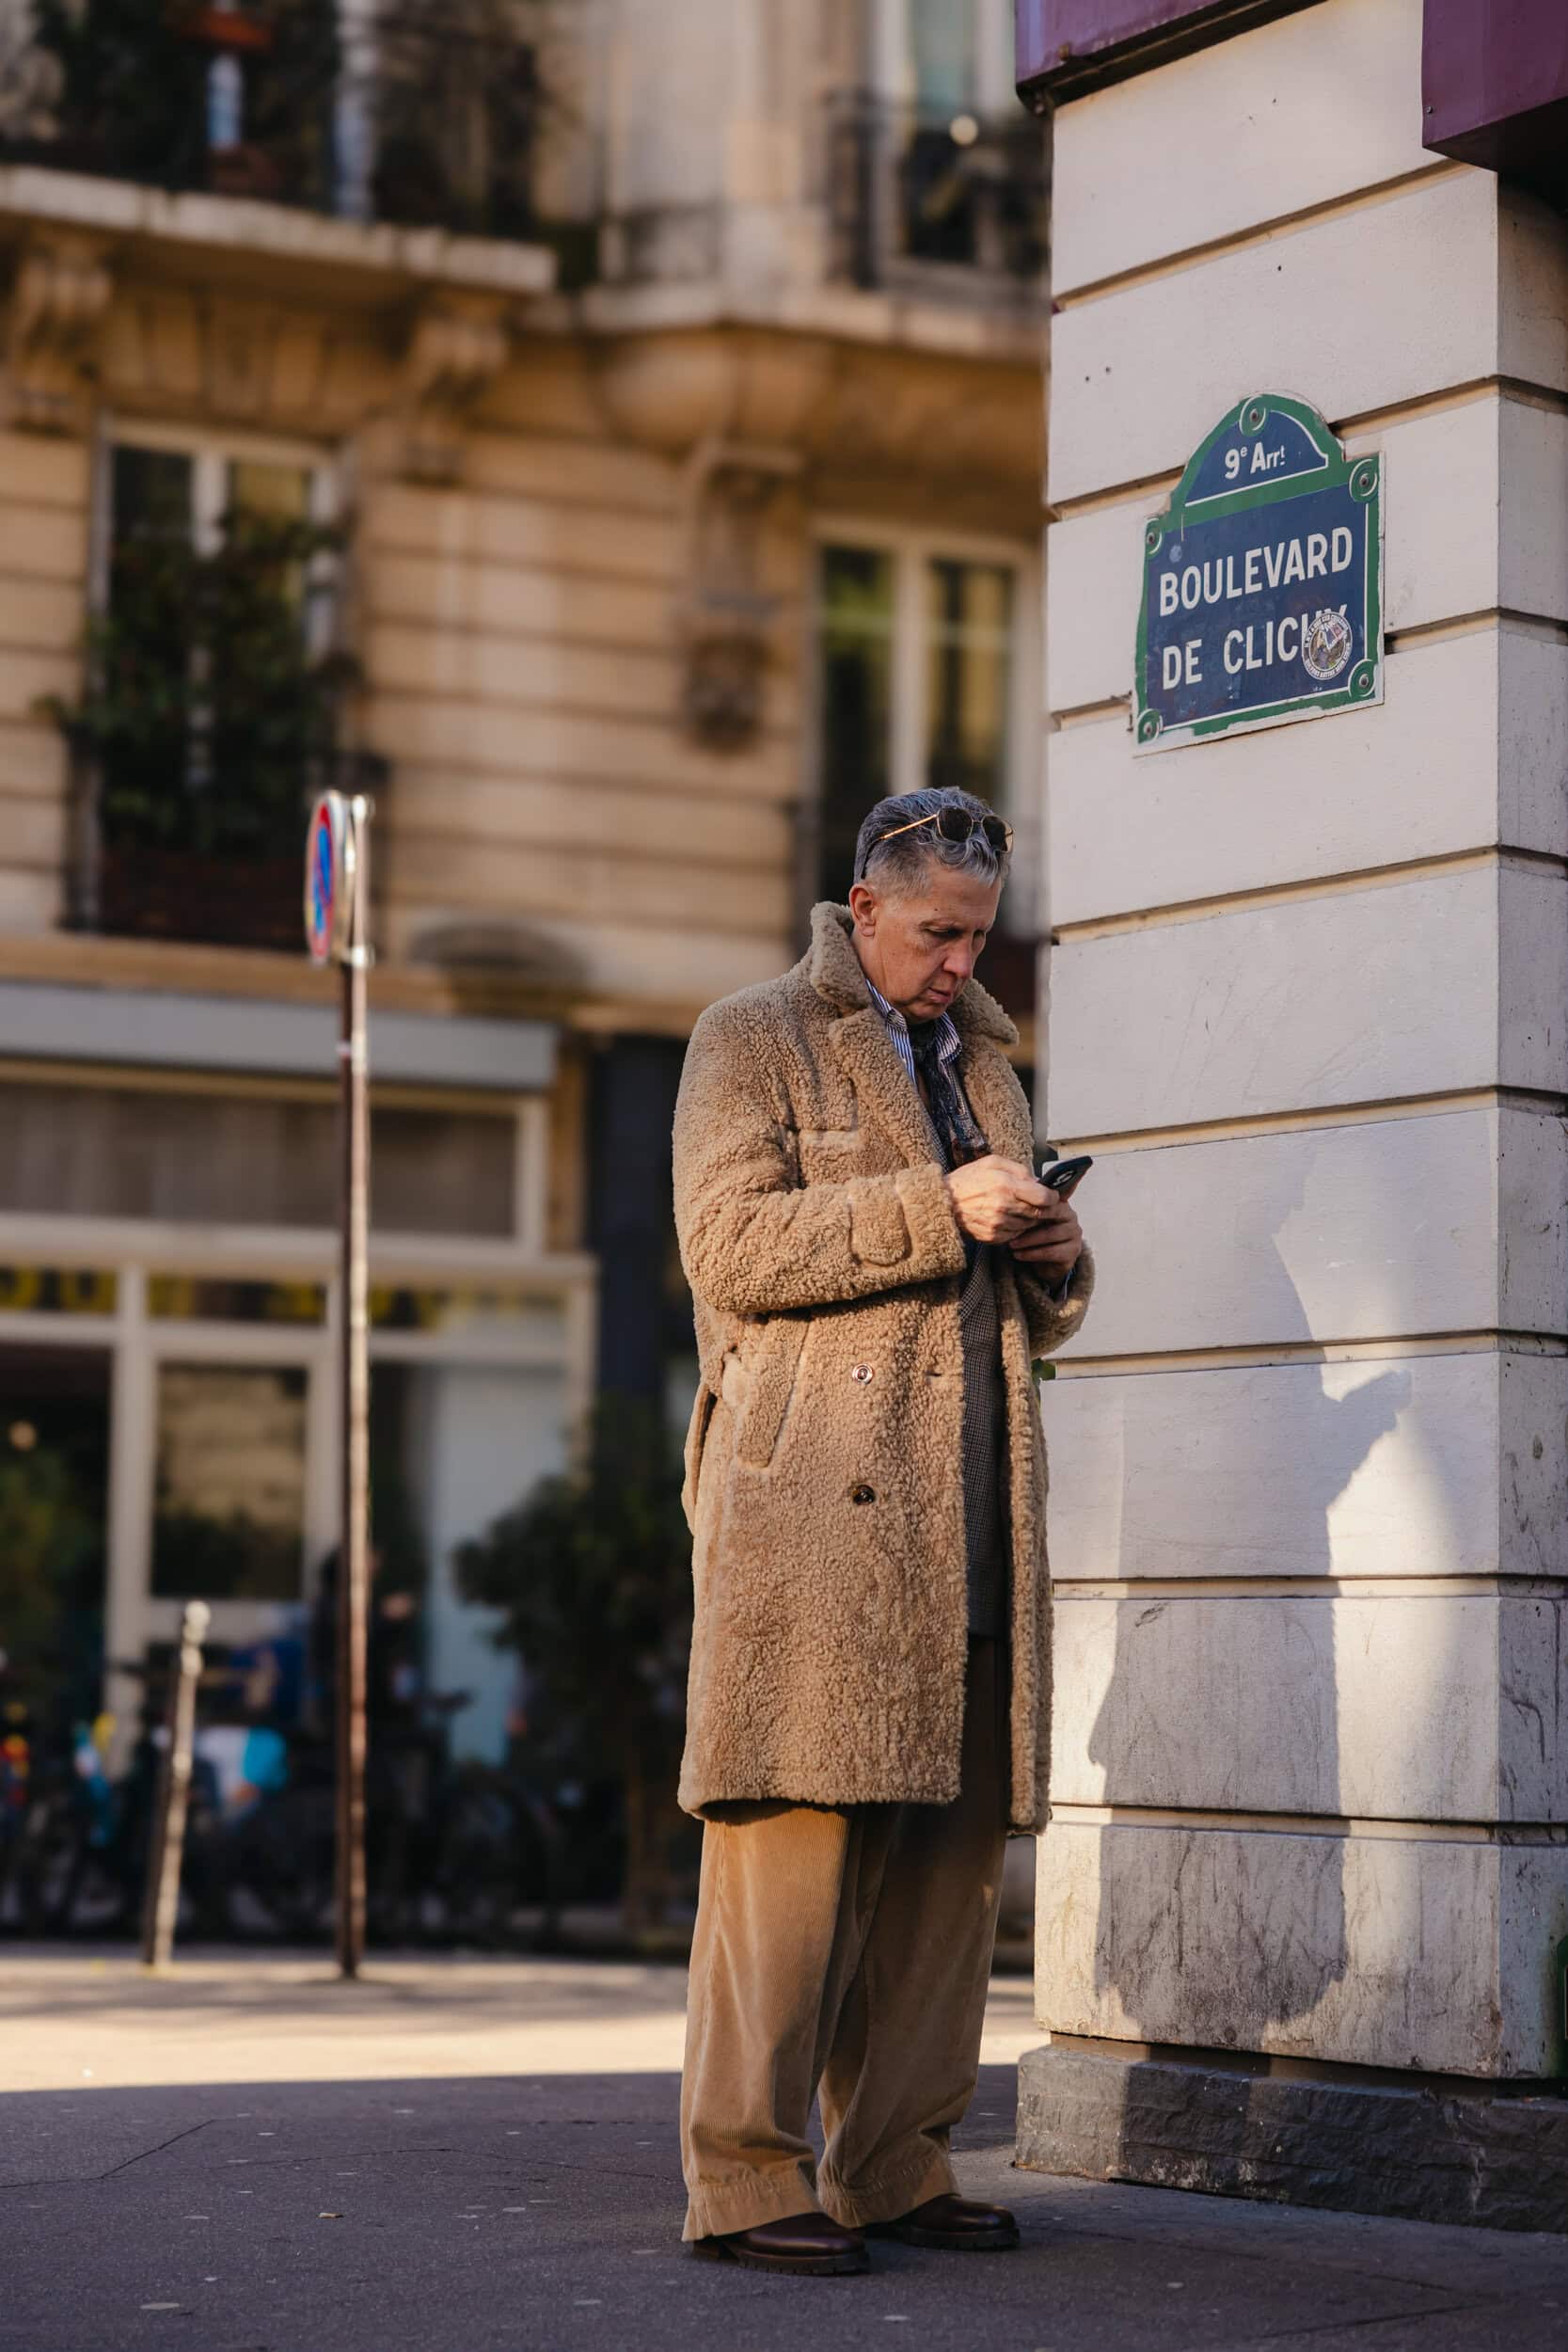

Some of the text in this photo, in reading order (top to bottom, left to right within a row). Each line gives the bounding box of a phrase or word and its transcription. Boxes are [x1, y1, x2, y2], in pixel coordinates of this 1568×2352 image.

[1160, 527, 1353, 616] BOULEVARD
[1163, 639, 1203, 690] DE
[1224, 604, 1347, 675] CLIC
